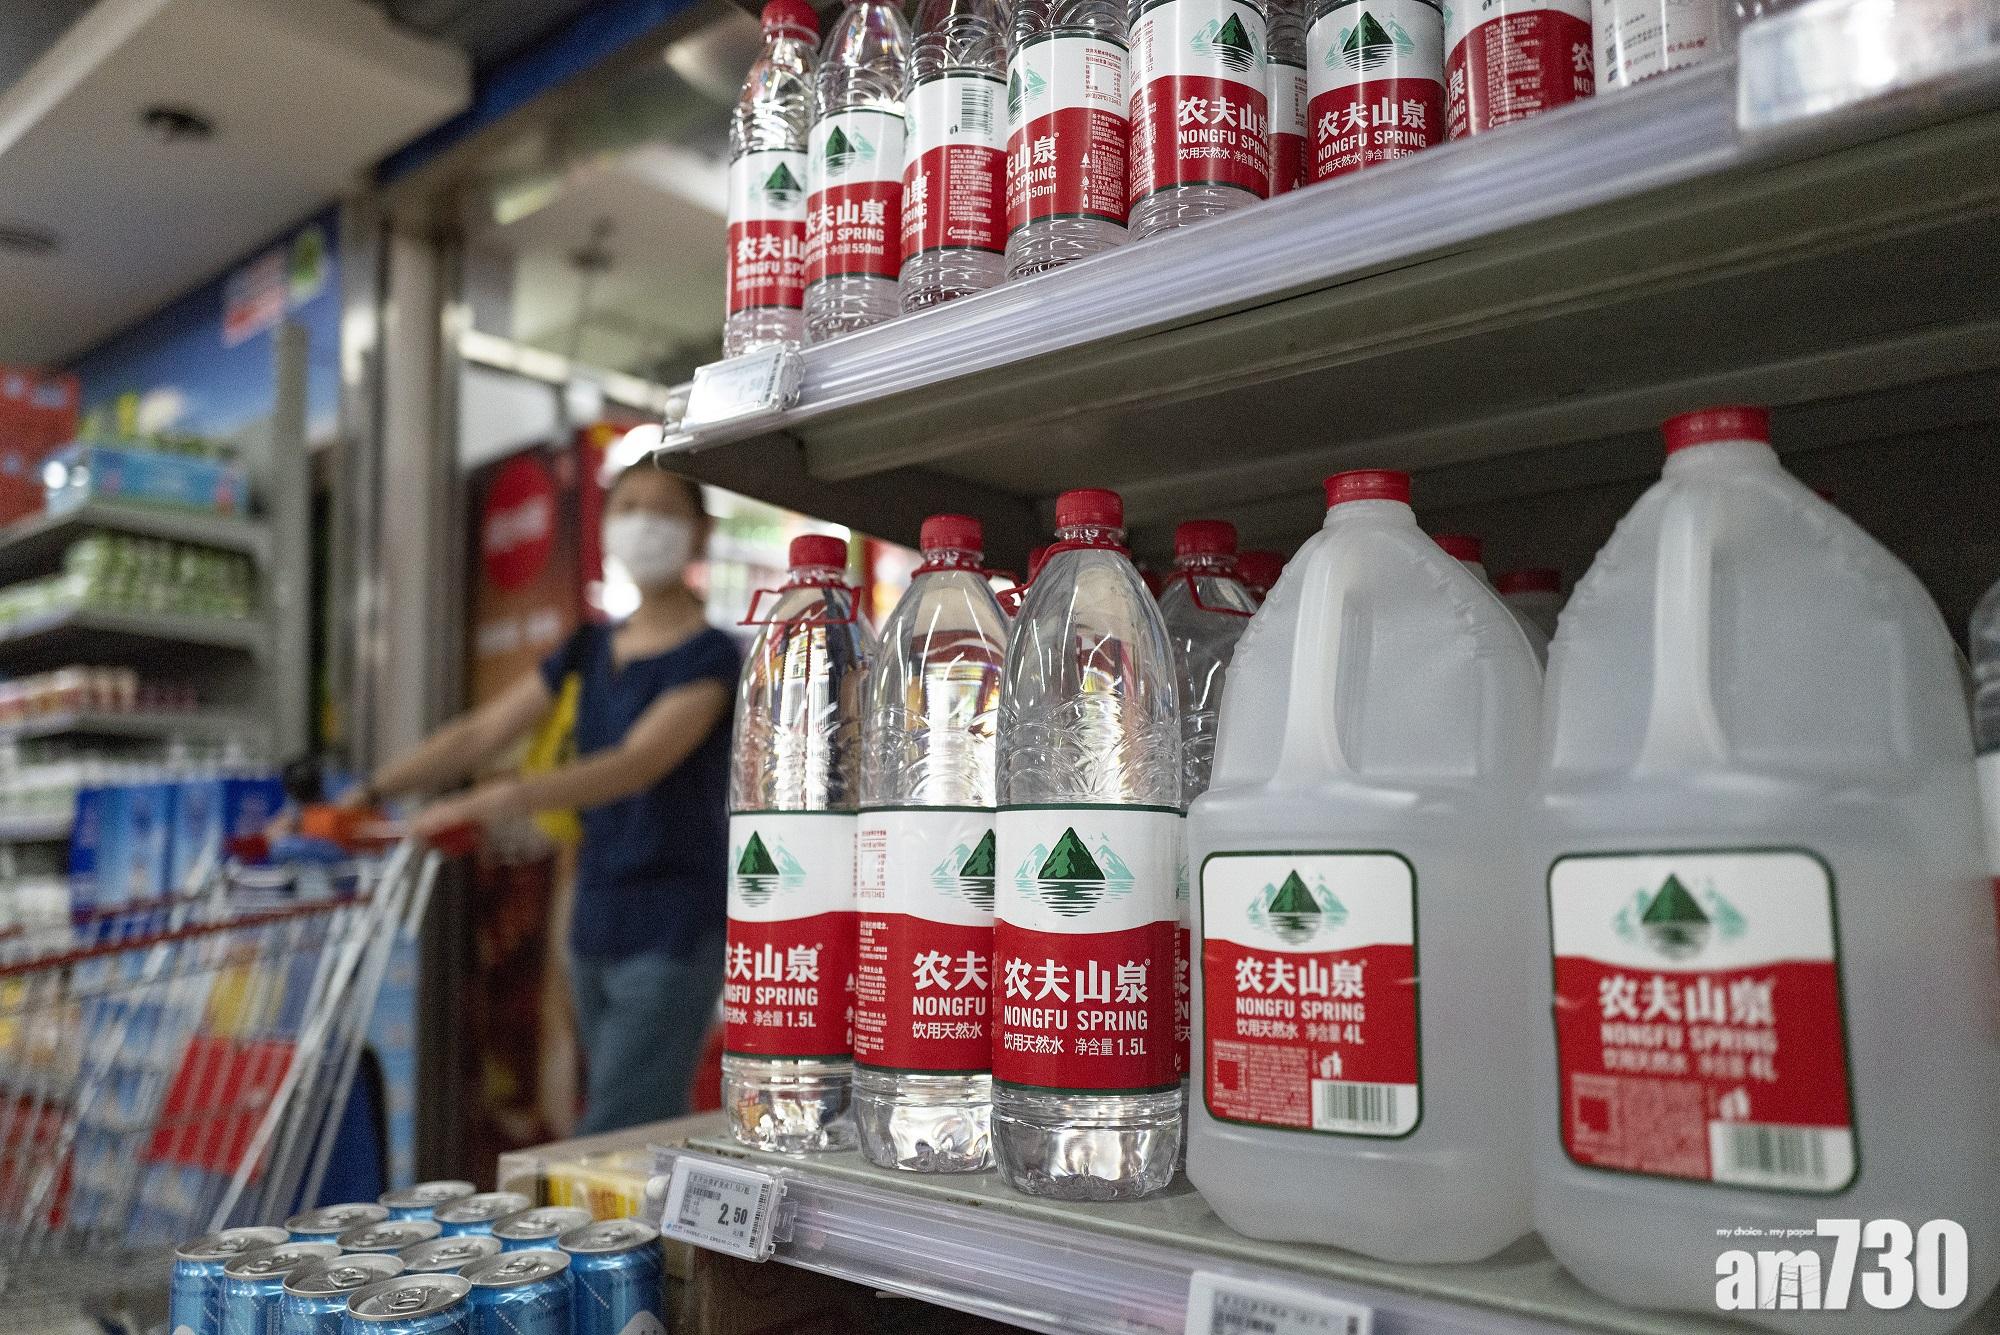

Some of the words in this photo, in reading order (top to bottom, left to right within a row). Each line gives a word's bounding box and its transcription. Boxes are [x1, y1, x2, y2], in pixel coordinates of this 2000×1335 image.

[1317, 97, 1426, 144] 农夫山泉
[1178, 129, 1236, 145] NONGFU
[1318, 132, 1368, 163] NONGFU
[1374, 130, 1426, 148] SPRING
[1178, 146, 1231, 160] 饮用天然水
[1318, 151, 1362, 178] 饮用天然水
[1015, 166, 1057, 191] SPRING
[837, 227, 885, 242] SPRING
[912, 951, 988, 991] 农夫
[1004, 956, 1148, 1003] 农夫山泉
[1235, 956, 1365, 999] 农夫山泉
[755, 987, 818, 1006] SPRING
[912, 996, 986, 1016] NONGFU
[1004, 1005, 1068, 1031] NONGFU
[1077, 1009, 1148, 1031] SPRING
[1236, 997, 1295, 1018] NONGFU
[1301, 1001, 1365, 1022] SPRING
[912, 1021, 983, 1040] 饮用天然水
[1236, 1019, 1299, 1040] 饮用天然水
[1004, 1031, 1065, 1055] 饮用天然水
[718, 1203, 748, 1226] 2.50
